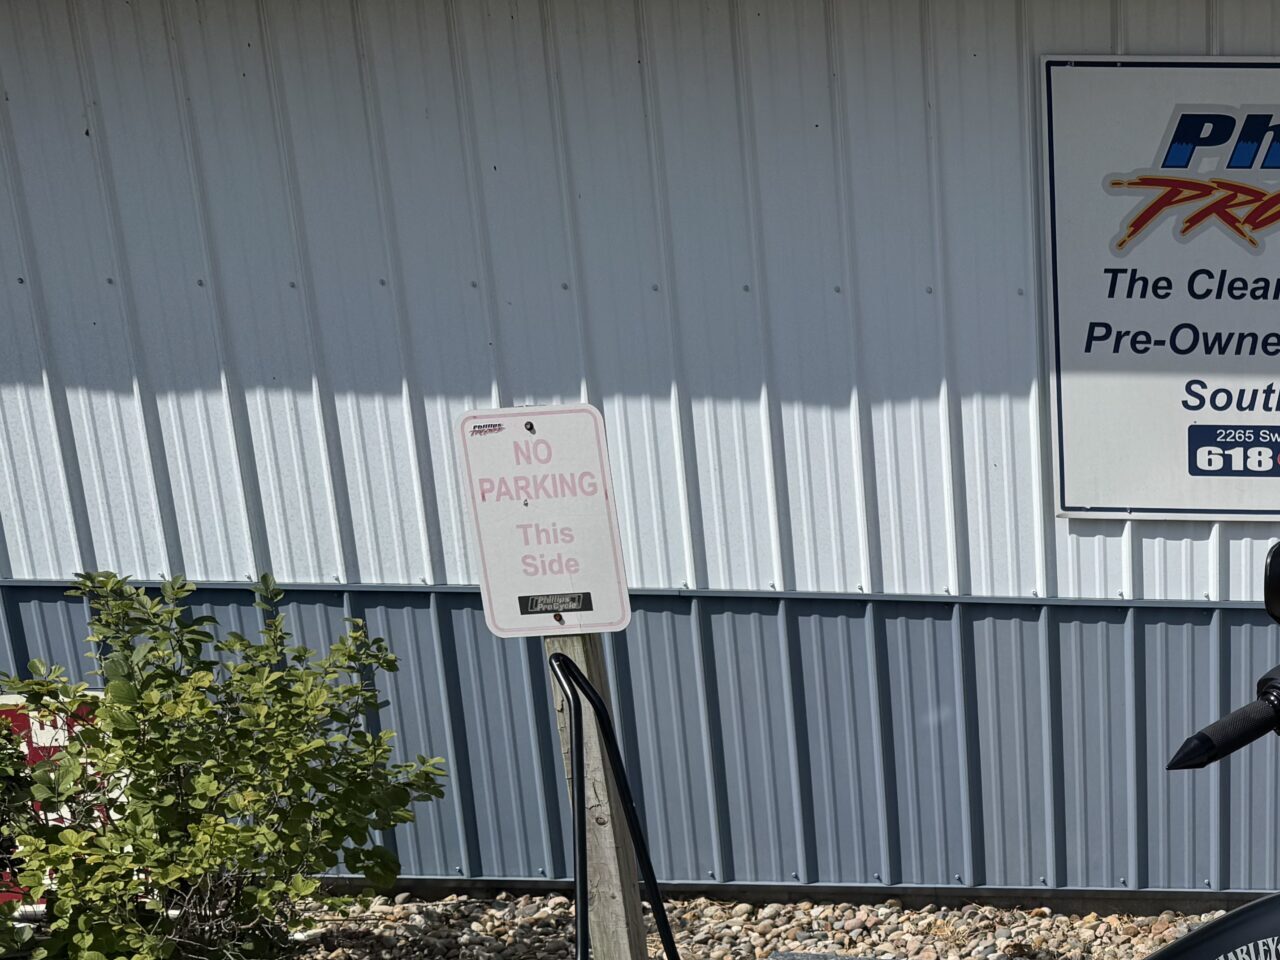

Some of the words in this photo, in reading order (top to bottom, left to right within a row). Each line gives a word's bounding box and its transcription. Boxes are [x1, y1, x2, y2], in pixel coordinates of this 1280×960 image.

[1102, 267, 1175, 301] The
[1216, 430, 1255, 442] 2265
[513, 438, 553, 466] NO
[478, 471, 598, 502] PARKING
[516, 522, 575, 546] This
[521, 553, 580, 577] Side
